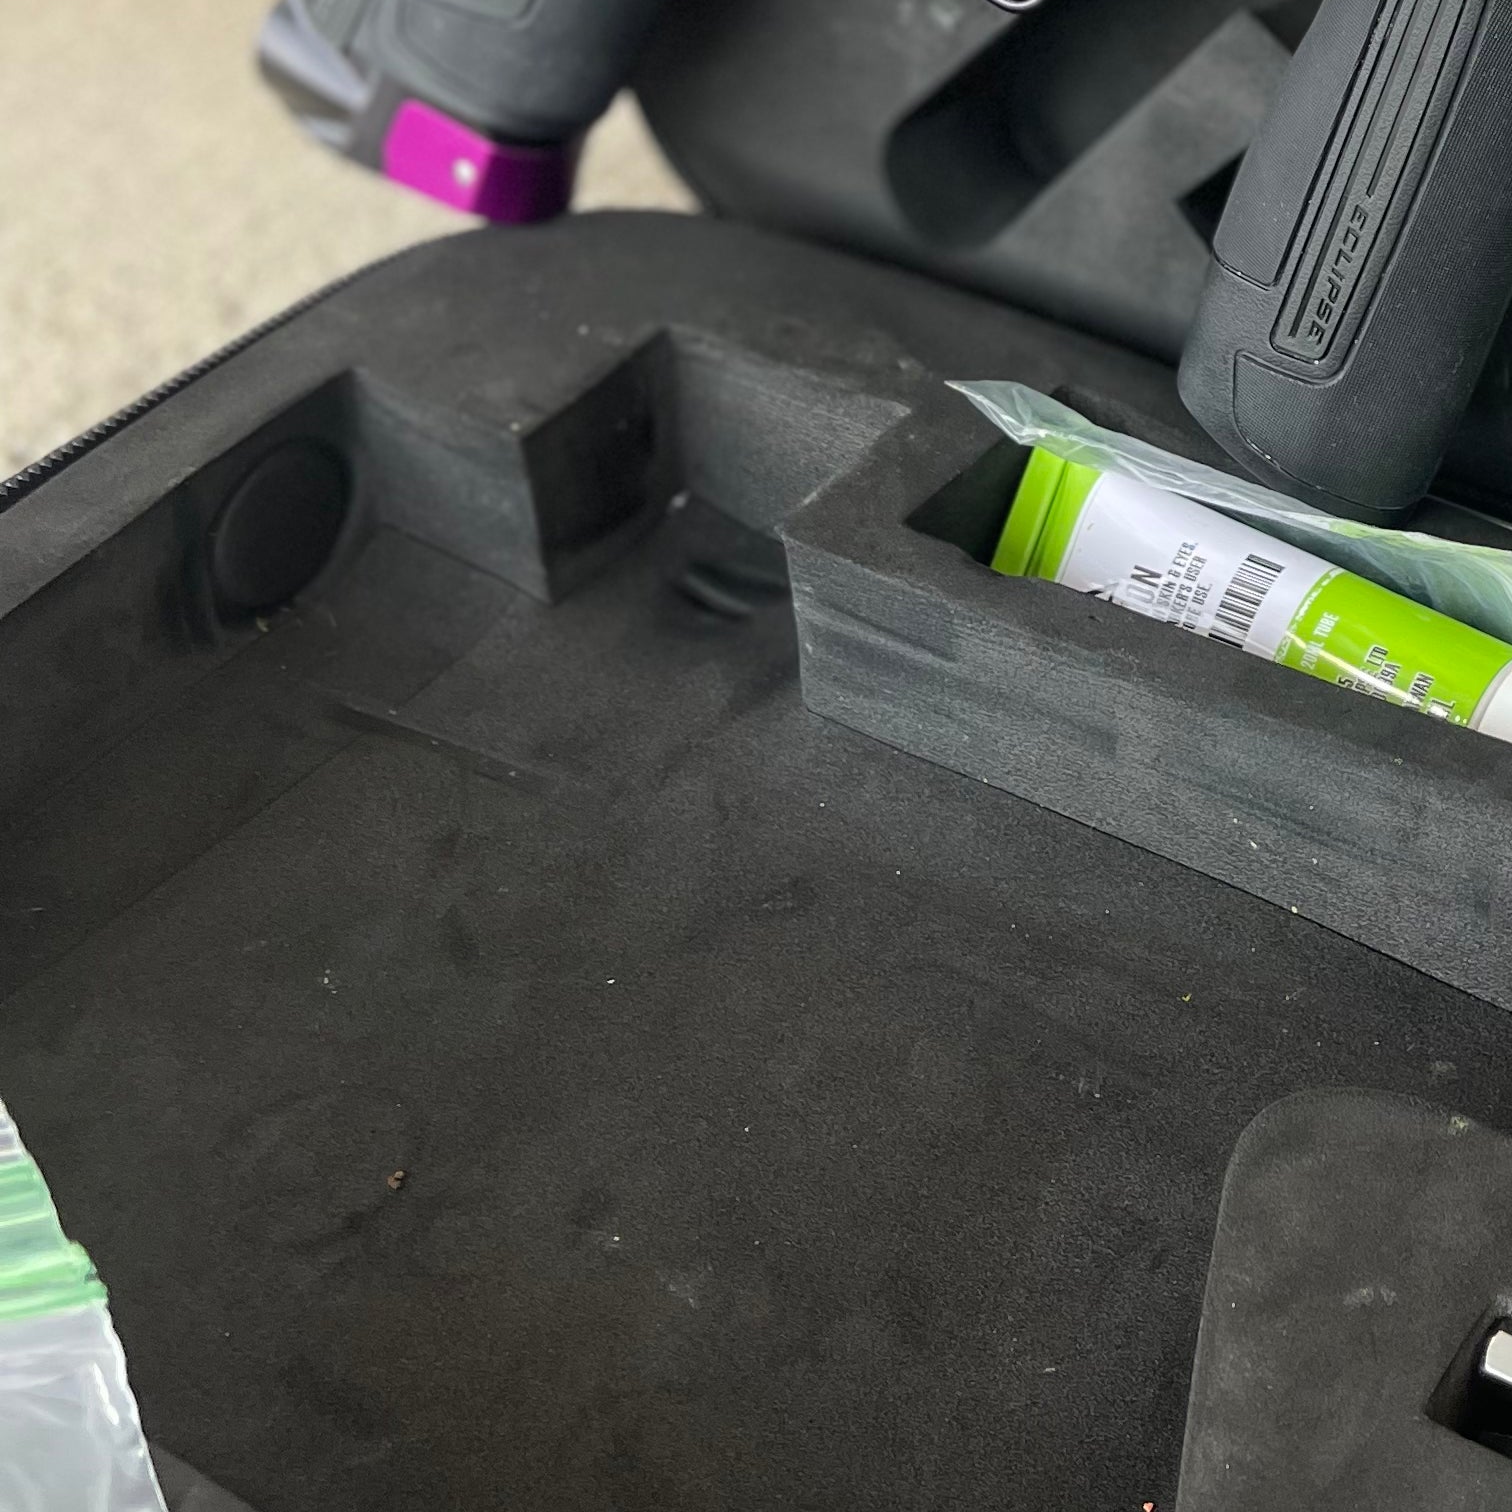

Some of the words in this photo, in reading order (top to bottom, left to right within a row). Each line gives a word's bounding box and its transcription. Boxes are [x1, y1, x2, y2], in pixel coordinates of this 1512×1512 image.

[1309, 204, 1369, 346] ECLIPSE
[1183, 555, 1208, 583] USER
[1156, 579, 1178, 607] SKIN
[1313, 611, 1341, 639] TUBE
[1366, 645, 1389, 667] LTD
